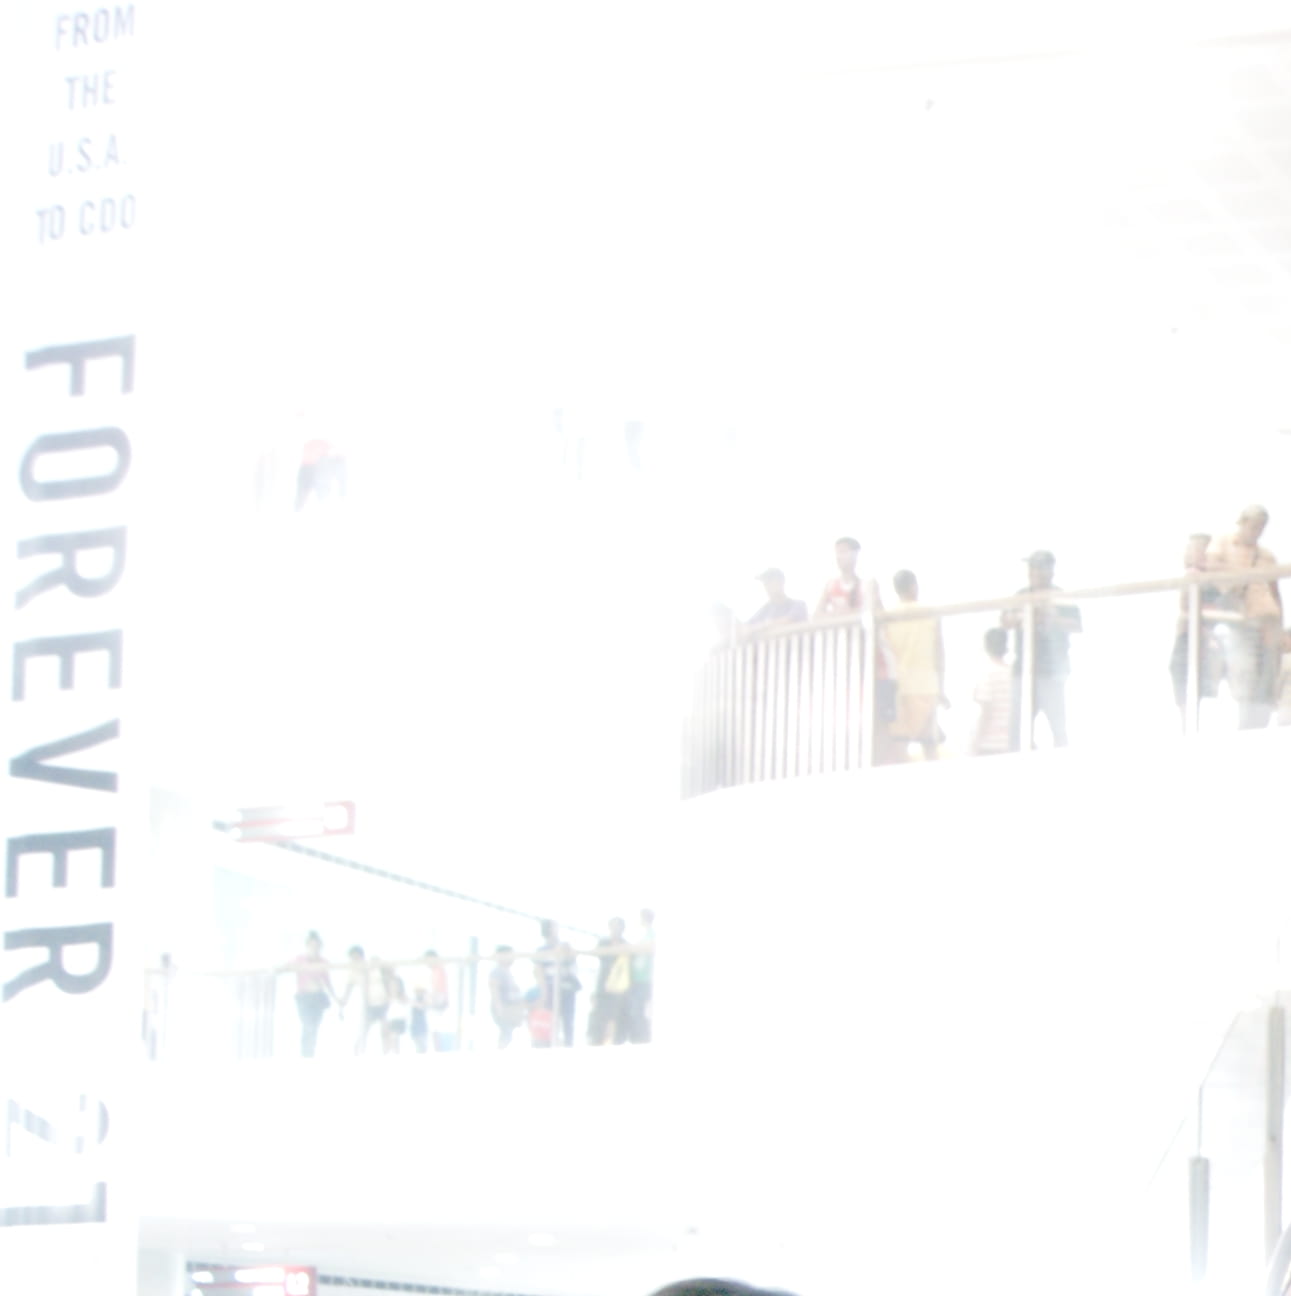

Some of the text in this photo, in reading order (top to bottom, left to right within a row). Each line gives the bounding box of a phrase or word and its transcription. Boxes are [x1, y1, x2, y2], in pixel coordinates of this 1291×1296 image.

[53, 3, 135, 52] FROM
[64, 69, 116, 111] THE
[35, 203, 66, 246] TO
[2, 333, 136, 1001] FOREVER
